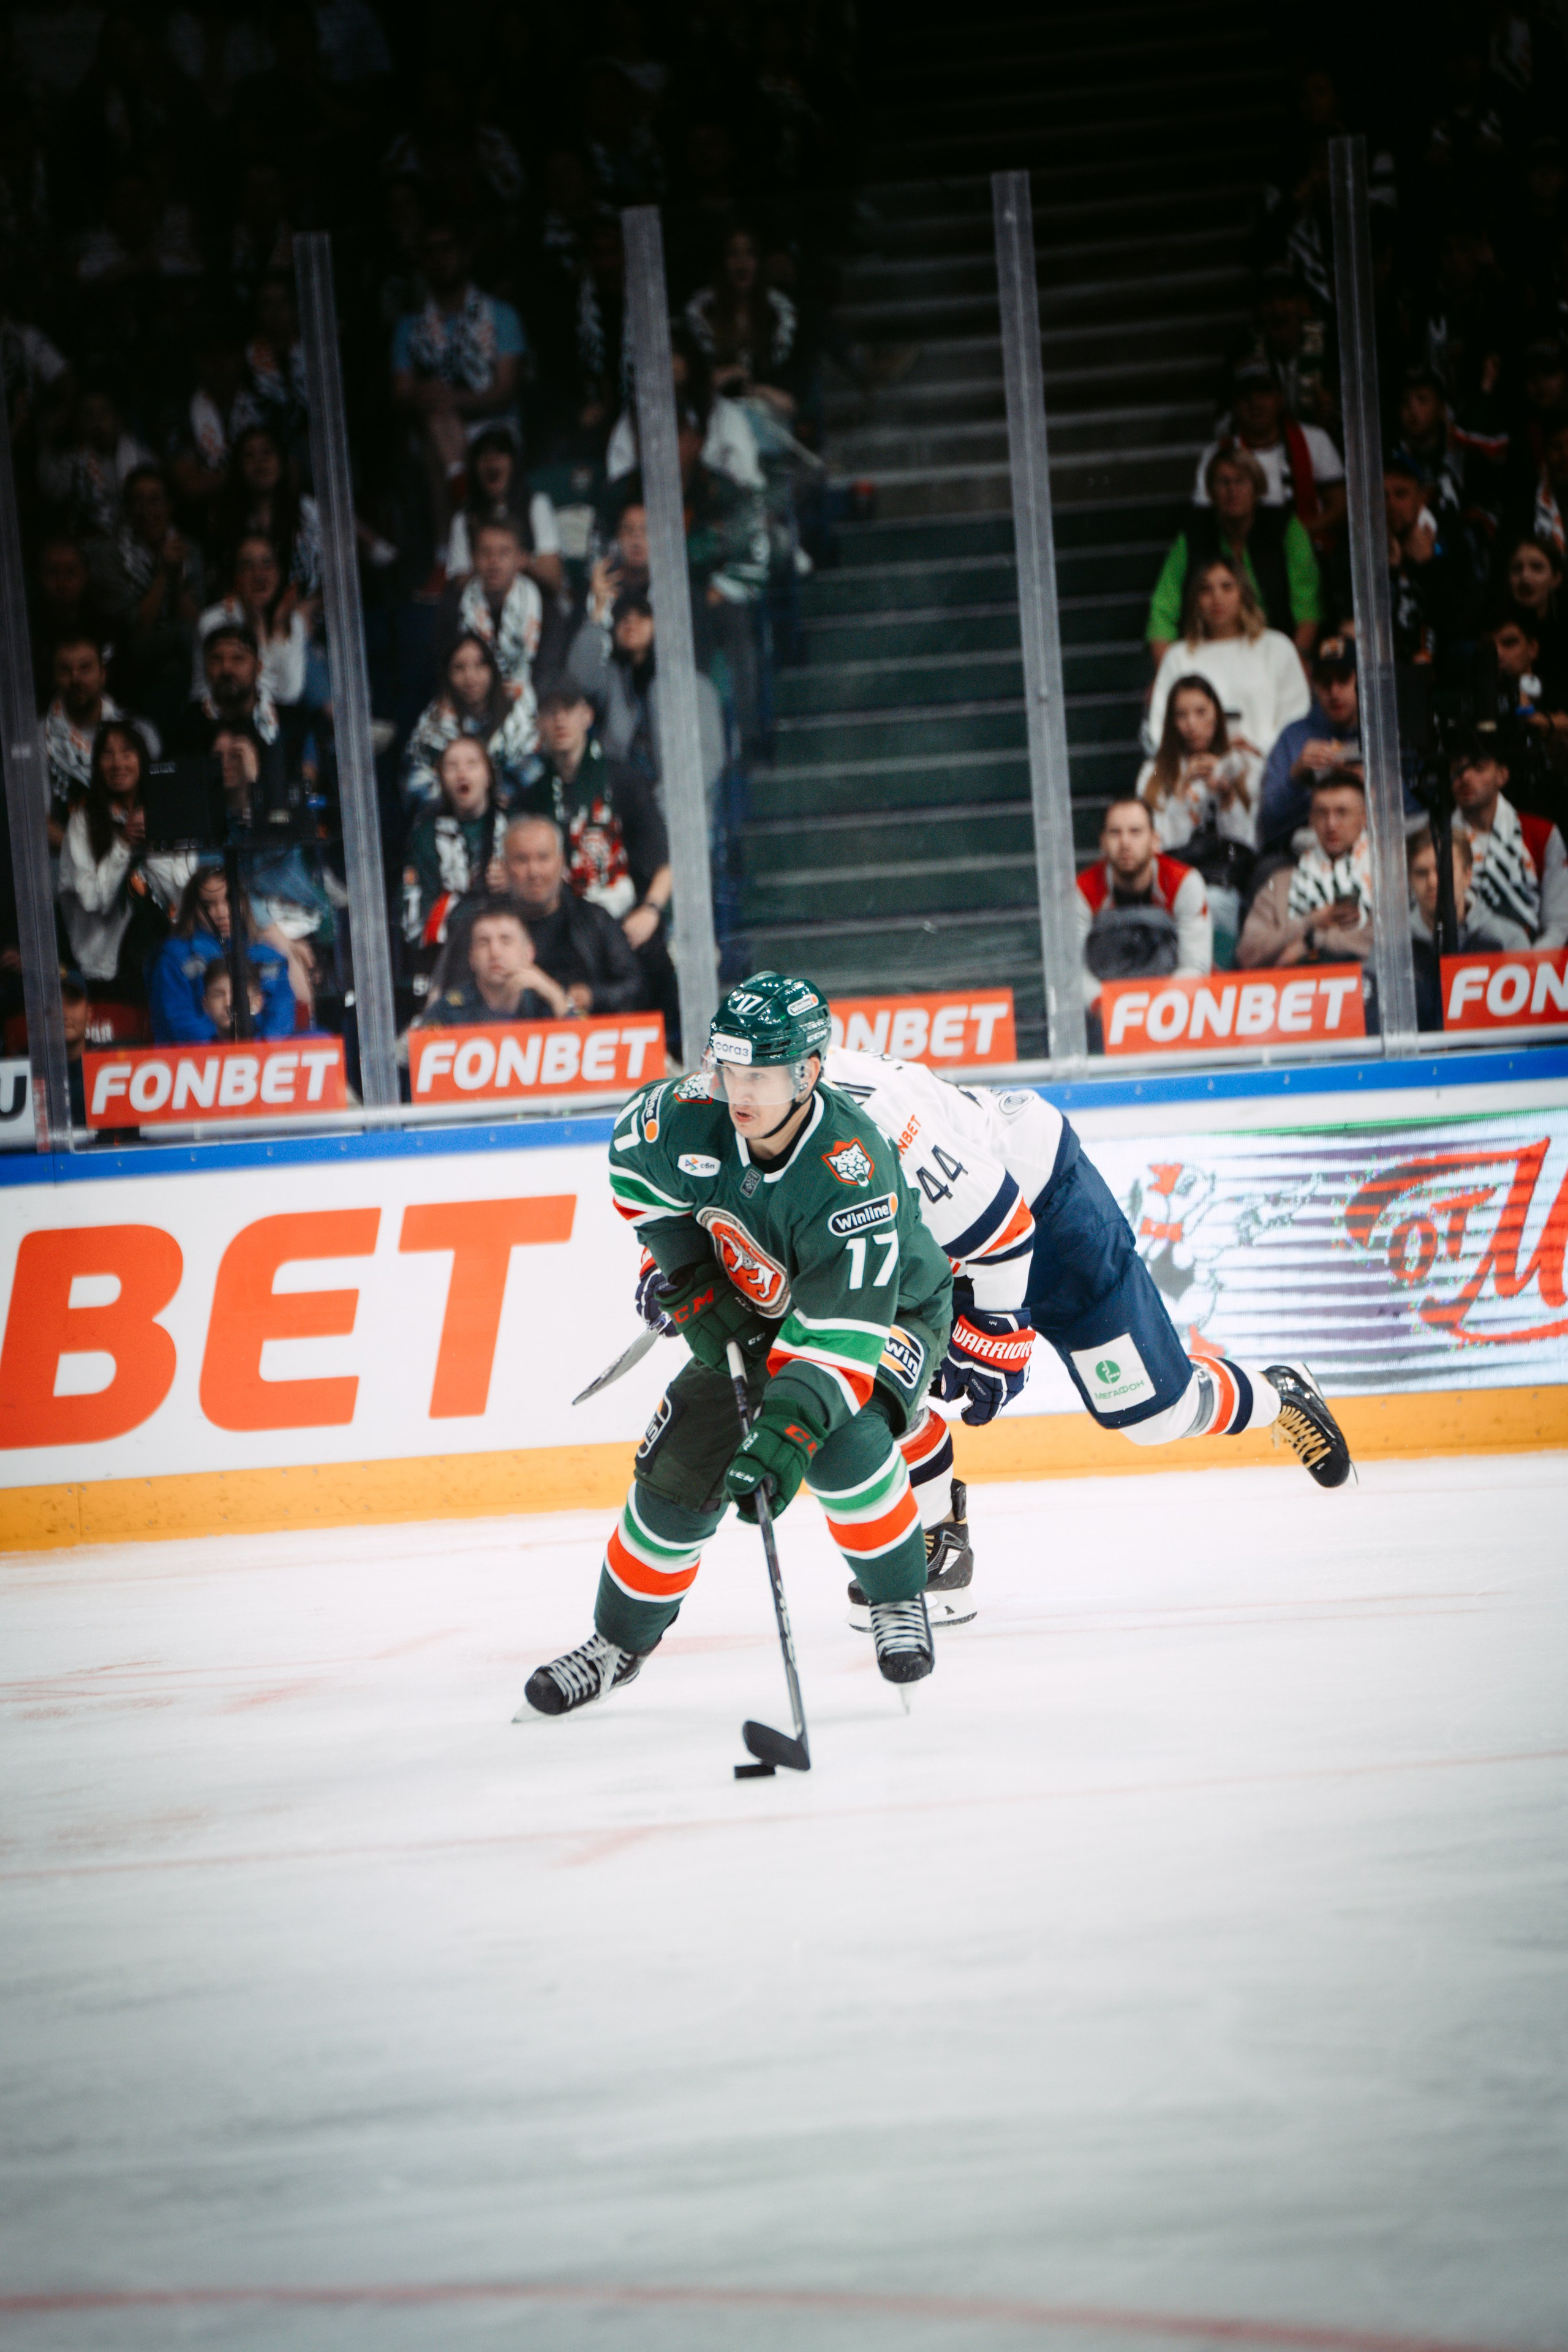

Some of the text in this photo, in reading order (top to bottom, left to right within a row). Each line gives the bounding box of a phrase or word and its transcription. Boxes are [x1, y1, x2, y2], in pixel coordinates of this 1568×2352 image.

[735, 994, 764, 1013] 17
[1108, 976, 1357, 1046] FONBET
[417, 1025, 660, 1093] FONBET
[715, 1041, 749, 1057] согаз
[91, 1048, 340, 1115] FONBET
[897, 1114, 922, 1156] NBET
[916, 1144, 969, 1204] 44
[835, 1204, 889, 1231] Winline
[845, 1229, 899, 1290] 17
[0, 1194, 577, 1452] BET
[672, 1287, 714, 1324] CM
[952, 1321, 1033, 1360] WARRIOR
[1095, 1379, 1145, 1400] МЕГАФОН
